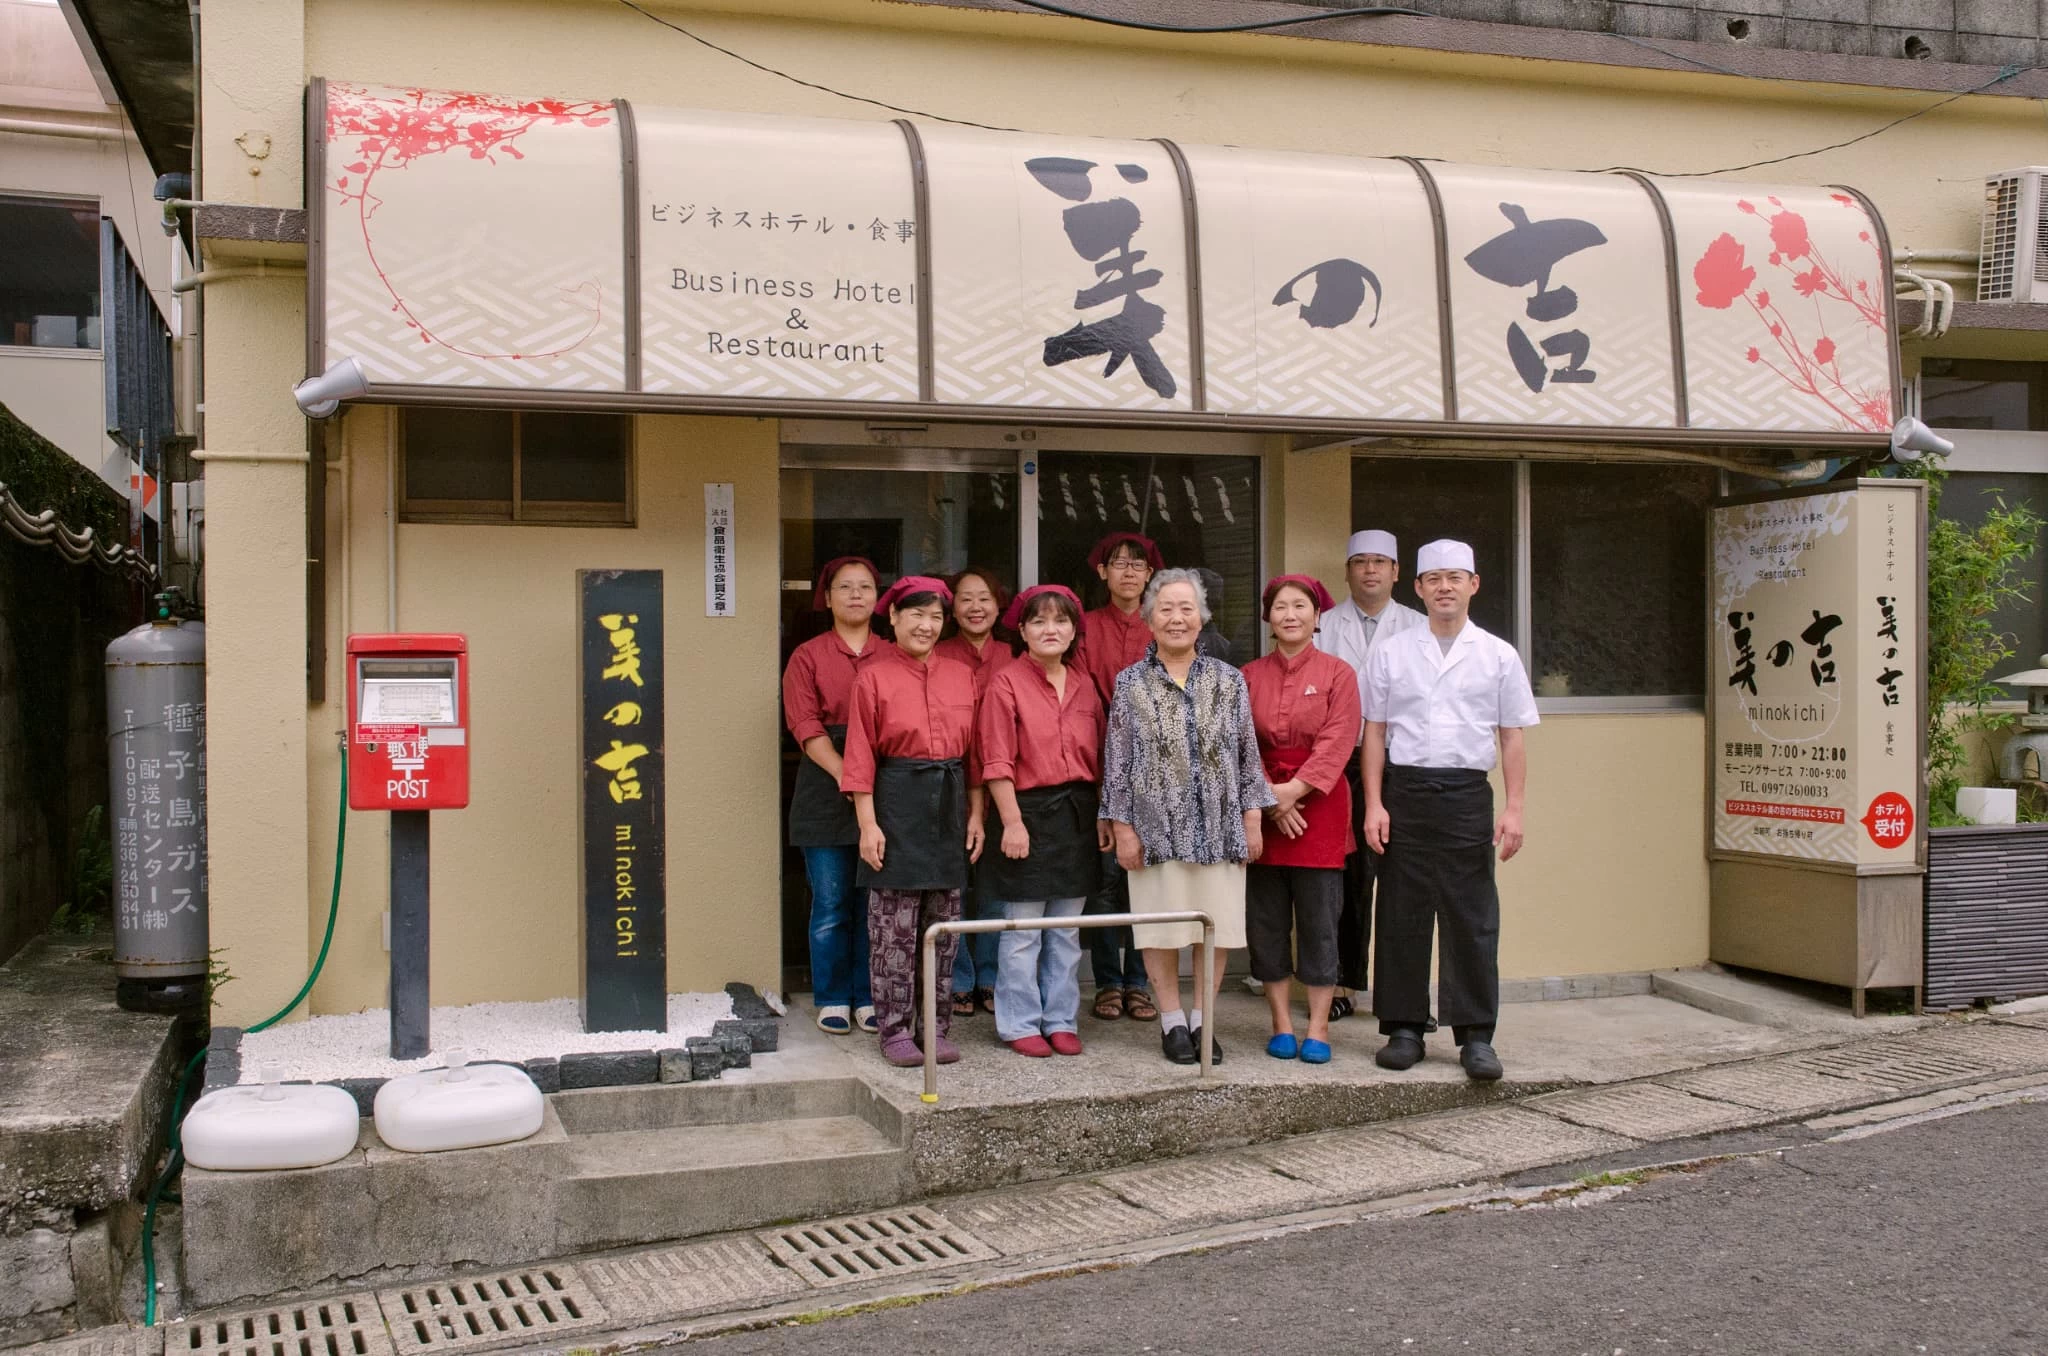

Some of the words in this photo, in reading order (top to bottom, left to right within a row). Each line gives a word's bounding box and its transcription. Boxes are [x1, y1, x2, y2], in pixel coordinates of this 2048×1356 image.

[651, 203, 917, 243] ビジネスホテル・食事
[671, 268, 815, 298] Business
[833, 278, 915, 305] Hotel
[785, 307, 809, 330] &
[708, 331, 886, 363] Restaurant
[1750, 543, 1788, 557] Business
[1791, 539, 1816, 552] Hotel
[1759, 568, 1807, 580] Restaurant
[1728, 609, 1843, 696] 美の吉
[1876, 596, 1904, 707] 美の吉
[594, 612, 650, 804] 美の吉
[1748, 703, 1826, 722] minokichi
[387, 736, 430, 758] 郵便
[1725, 742, 1763, 758] 営業時間
[1771, 744, 1798, 759] 7:00
[1725, 763, 1793, 777] モーニングサービス
[387, 779, 430, 799] POST
[1761, 782, 1828, 798] 0997(26)0033
[163, 703, 199, 914] 種子島ガス
[1875, 803, 1906, 816] ホテル
[1875, 818, 1906, 837] 受付
[614, 824, 639, 958] minokichi
